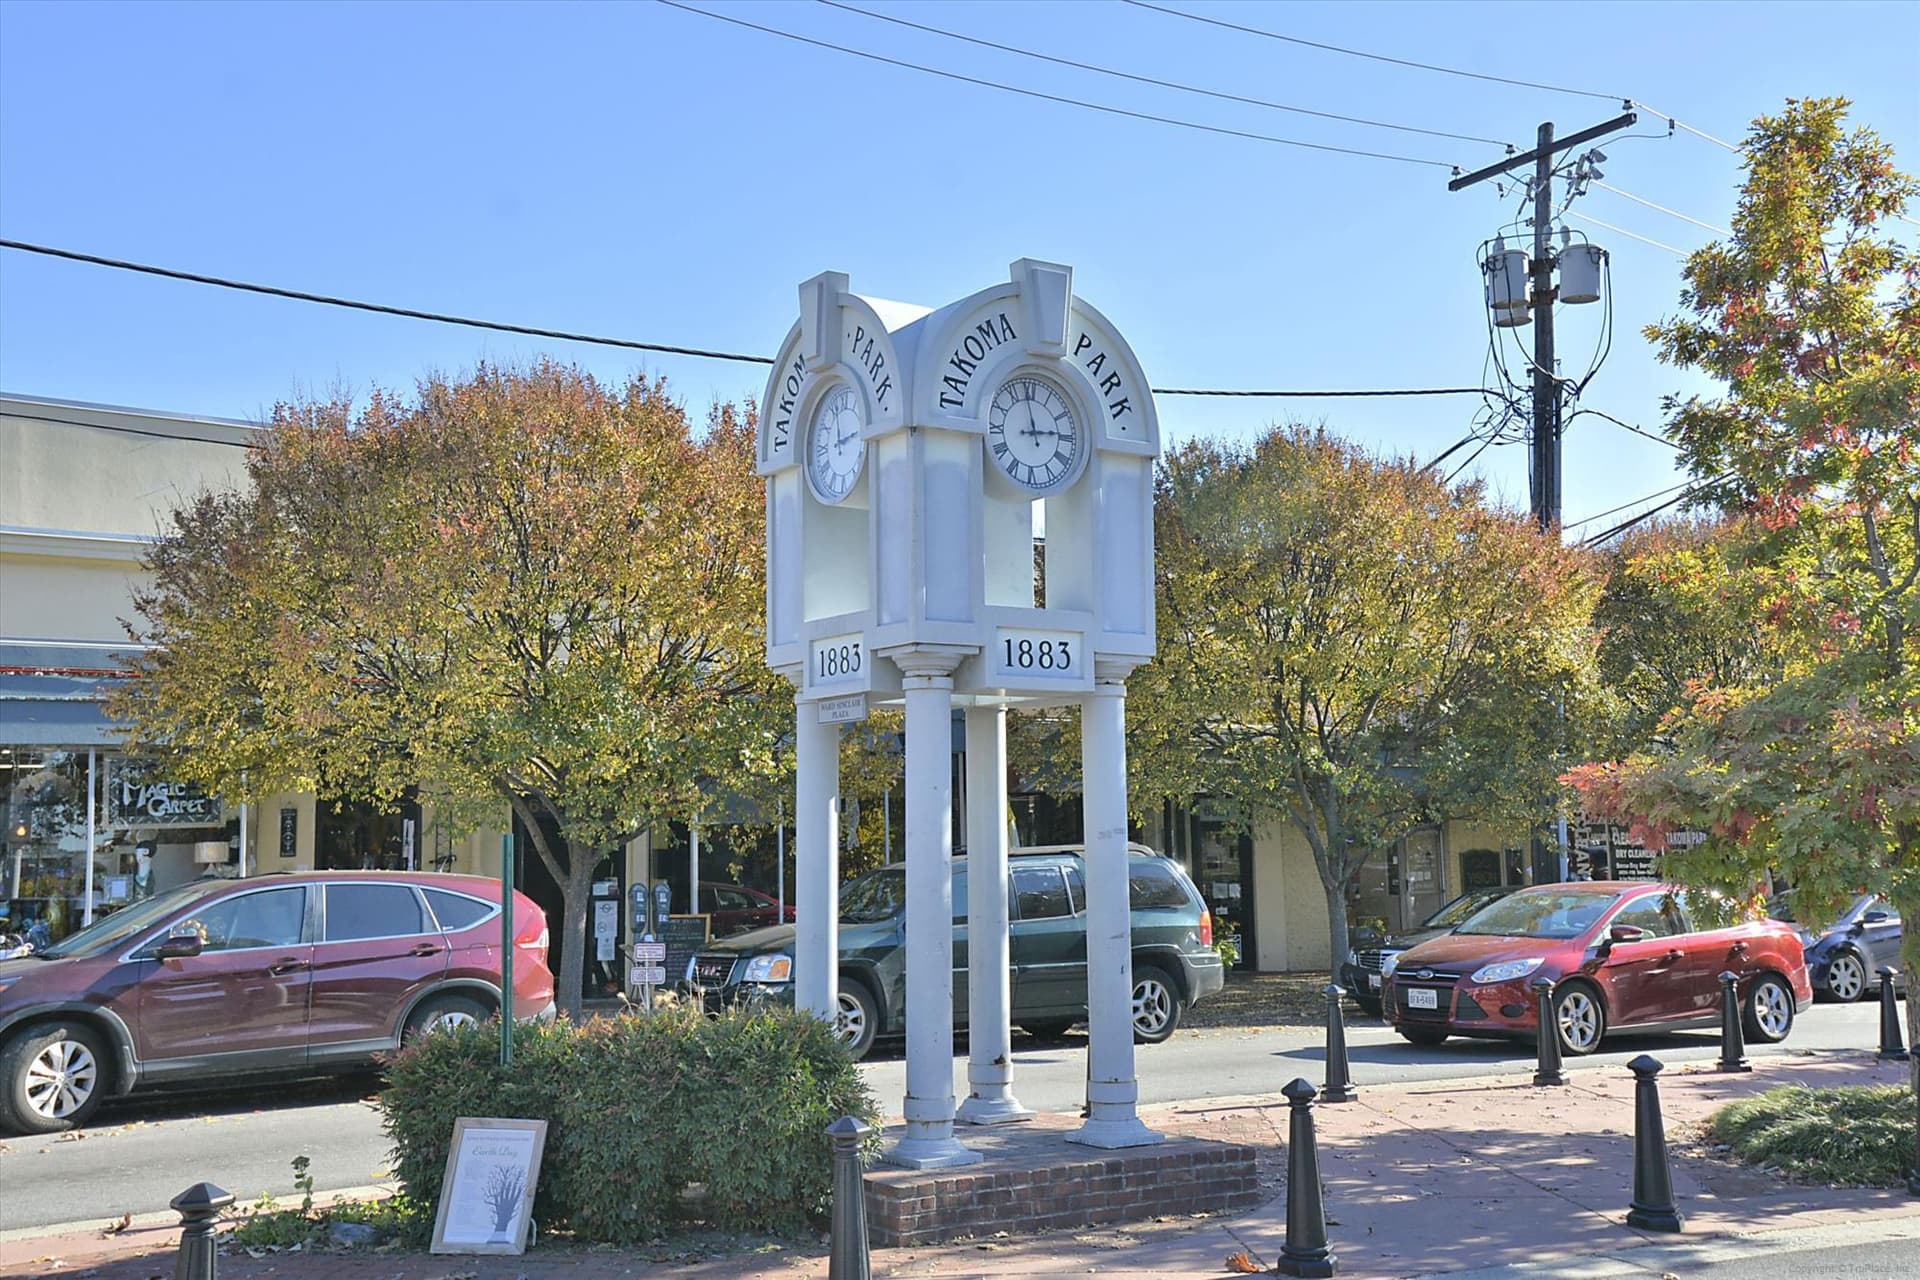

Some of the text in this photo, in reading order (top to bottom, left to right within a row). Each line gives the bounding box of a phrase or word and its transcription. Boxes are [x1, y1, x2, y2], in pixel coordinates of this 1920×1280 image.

[939, 313, 1017, 409] TAKOMA
[774, 353, 808, 452] TAKOM
[819, 643, 862, 677] 1883
[1004, 638, 1071, 670] 1883
